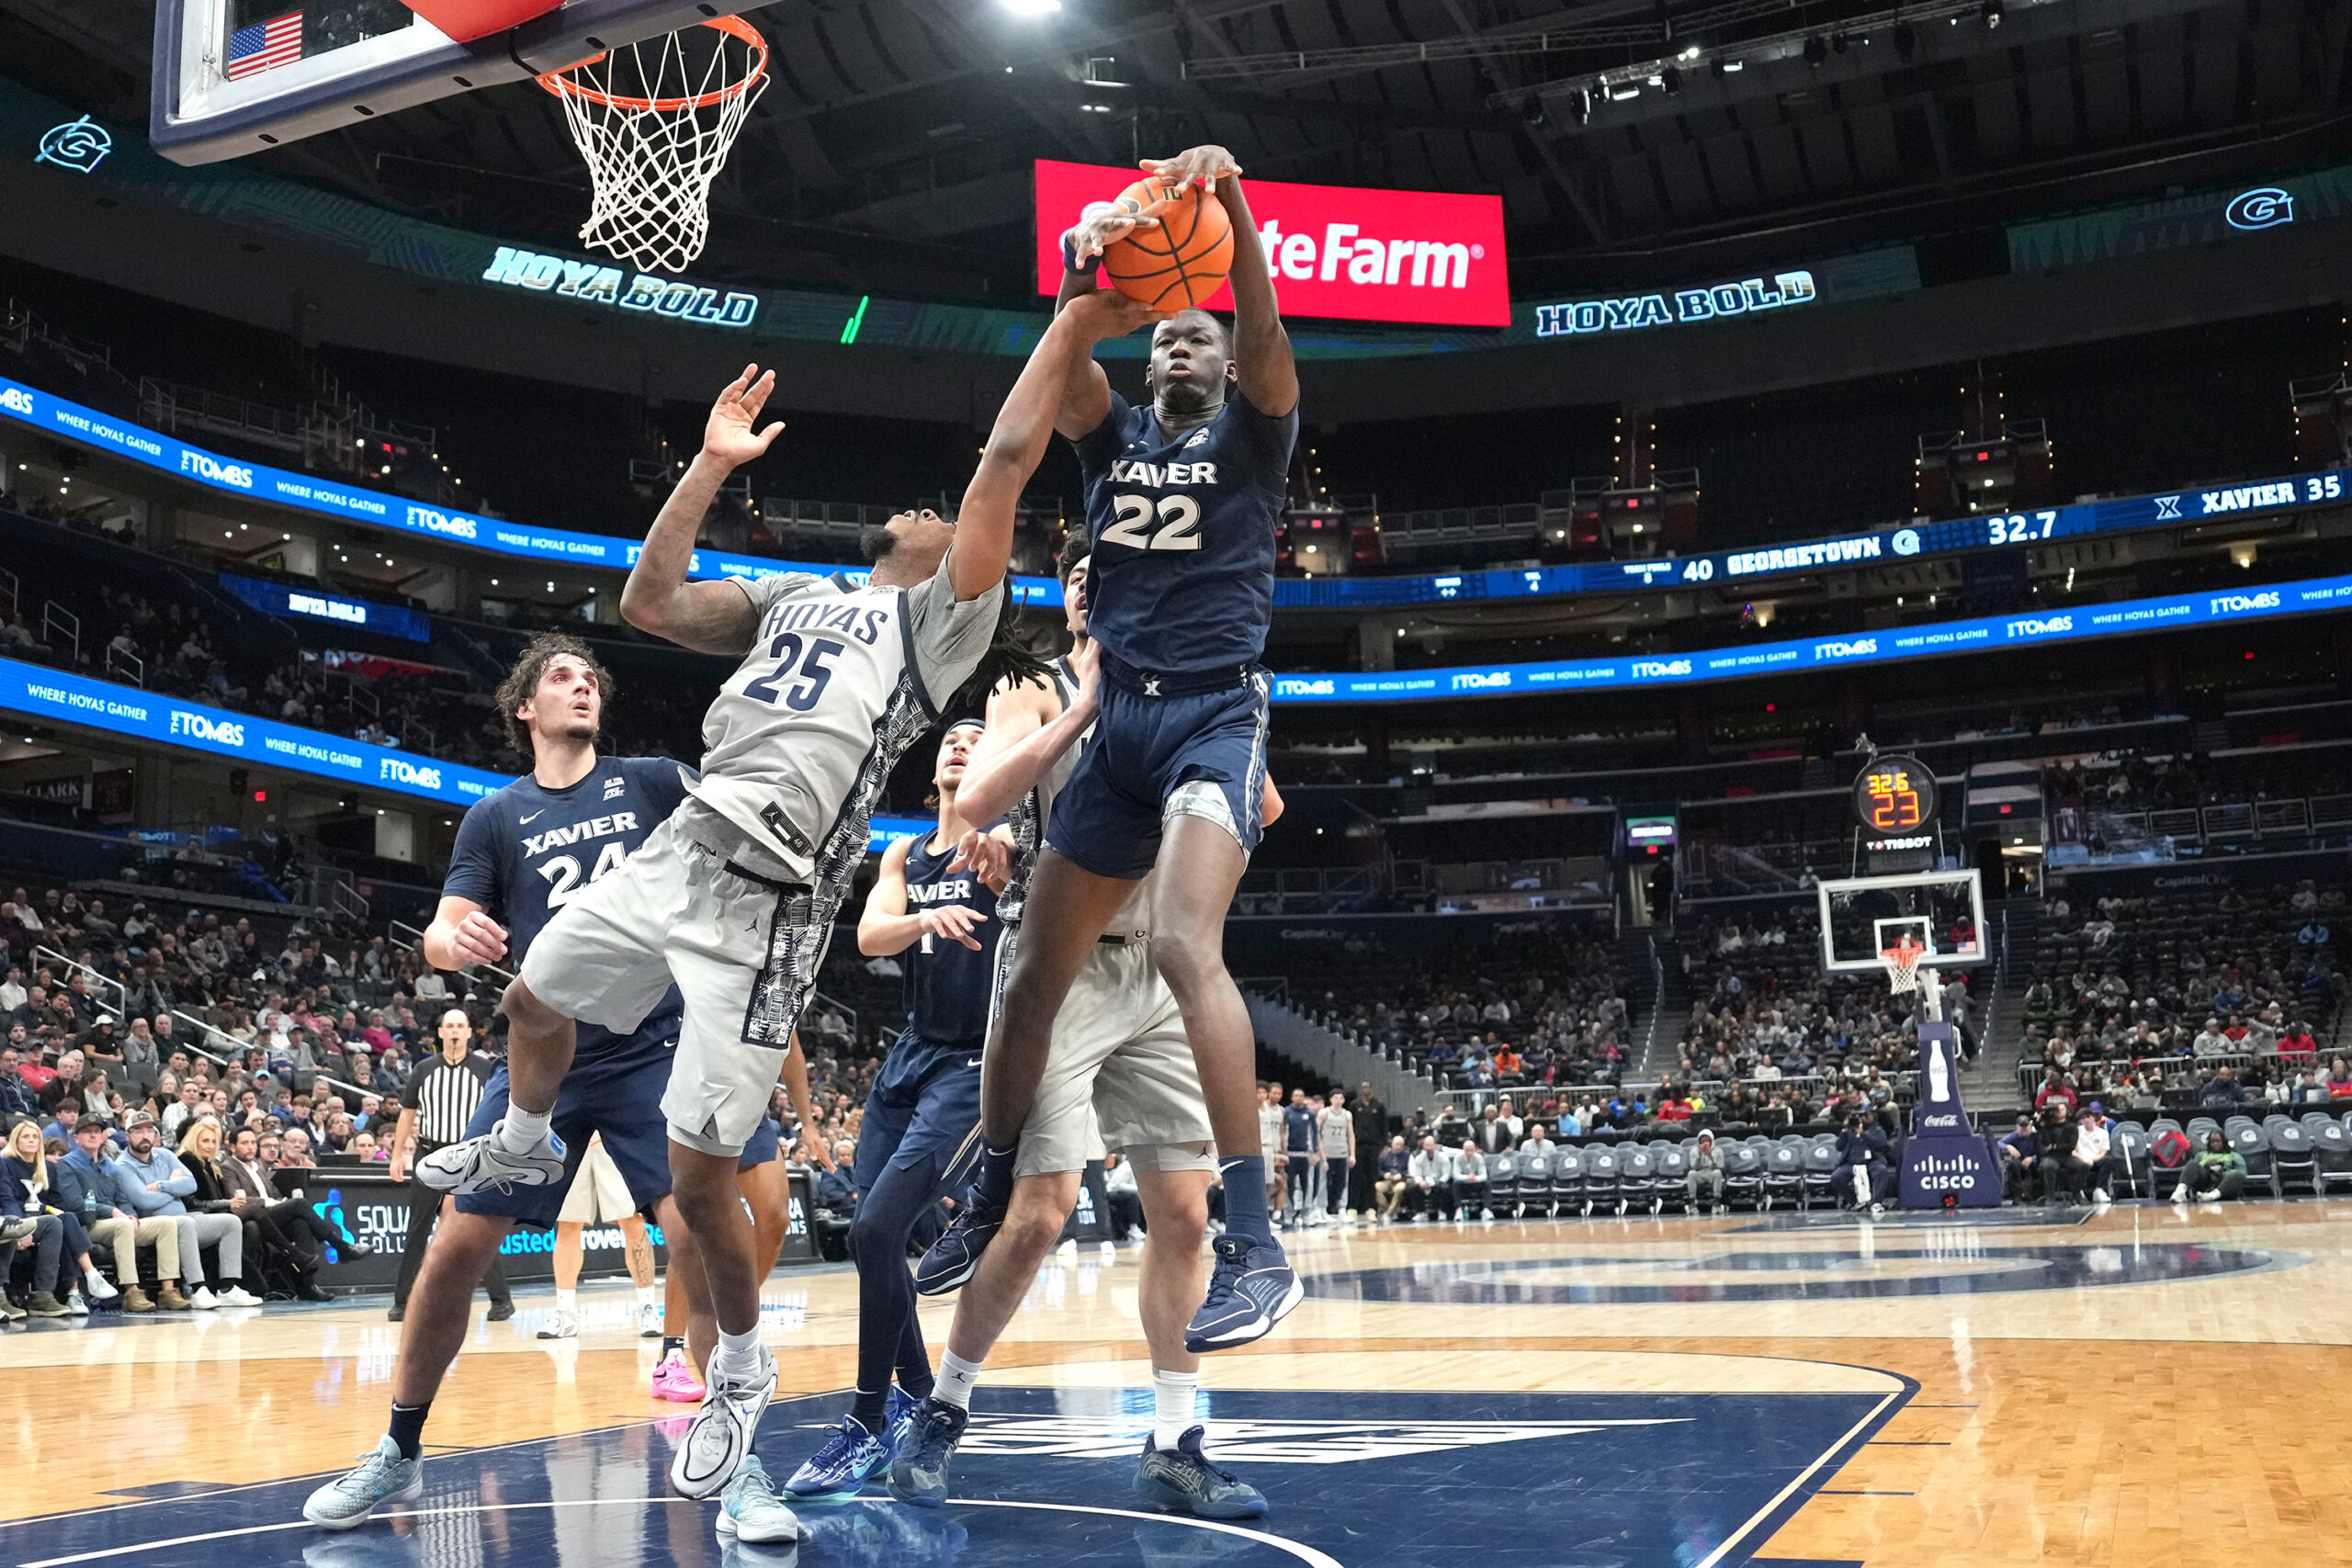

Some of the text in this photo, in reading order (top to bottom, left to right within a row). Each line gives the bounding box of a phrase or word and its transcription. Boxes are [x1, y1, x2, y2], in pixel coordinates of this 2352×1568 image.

[482, 246, 759, 326] HOYA BOLD
[1536, 270, 1816, 336] HOYA BOLD
[56, 410, 162, 457] WHERE HOYAS GATHER
[188, 451, 253, 489] TOMBS
[1106, 459, 1218, 489] XAVER
[277, 481, 386, 514] WHERE HOYAS GATHER
[2201, 475, 2342, 514] XAVIER 35
[415, 507, 477, 539] TOMBS
[1099, 493, 1202, 551] 22
[1987, 510, 2057, 546] 32.7
[496, 532, 605, 556] WHERE HOYAS GATHER
[1682, 558, 1714, 581] 40
[1726, 535, 1882, 577] GEORGETOWN
[2219, 591, 2280, 612] TOMBS
[2301, 589, 2334, 600] WHERE
[763, 604, 888, 646] HOYAS
[2014, 615, 2074, 636] TOMBS
[2092, 605, 2190, 624] WHERE HOYAS GATHER
[1821, 638, 1878, 658] TOMBS
[1895, 629, 1988, 647] WHERE HOYAS GATHER
[741, 631, 846, 712] 25
[1638, 660, 1692, 677] TOMBS
[1709, 650, 1797, 668] WHERE HOYAS GATHER
[1284, 680, 1335, 695] TOMBS
[1460, 671, 1511, 689] TOMBS
[1528, 671, 1555, 681] WHERE
[28, 682, 148, 721] WHERE HOYAS GATHER
[170, 710, 244, 747] THE TOMBS
[265, 737, 362, 768] WHERE HOYAS GATHER
[388, 759, 442, 790] TOMBS
[458, 781, 483, 795] WHERE
[1867, 772, 1909, 795] 32.6
[1872, 790, 1921, 828] 23
[520, 811, 639, 859] XAVIER
[1883, 836, 1933, 851] TISSOT
[907, 879, 972, 903] AVIER
[1920, 1175, 1975, 1190] CISCO
